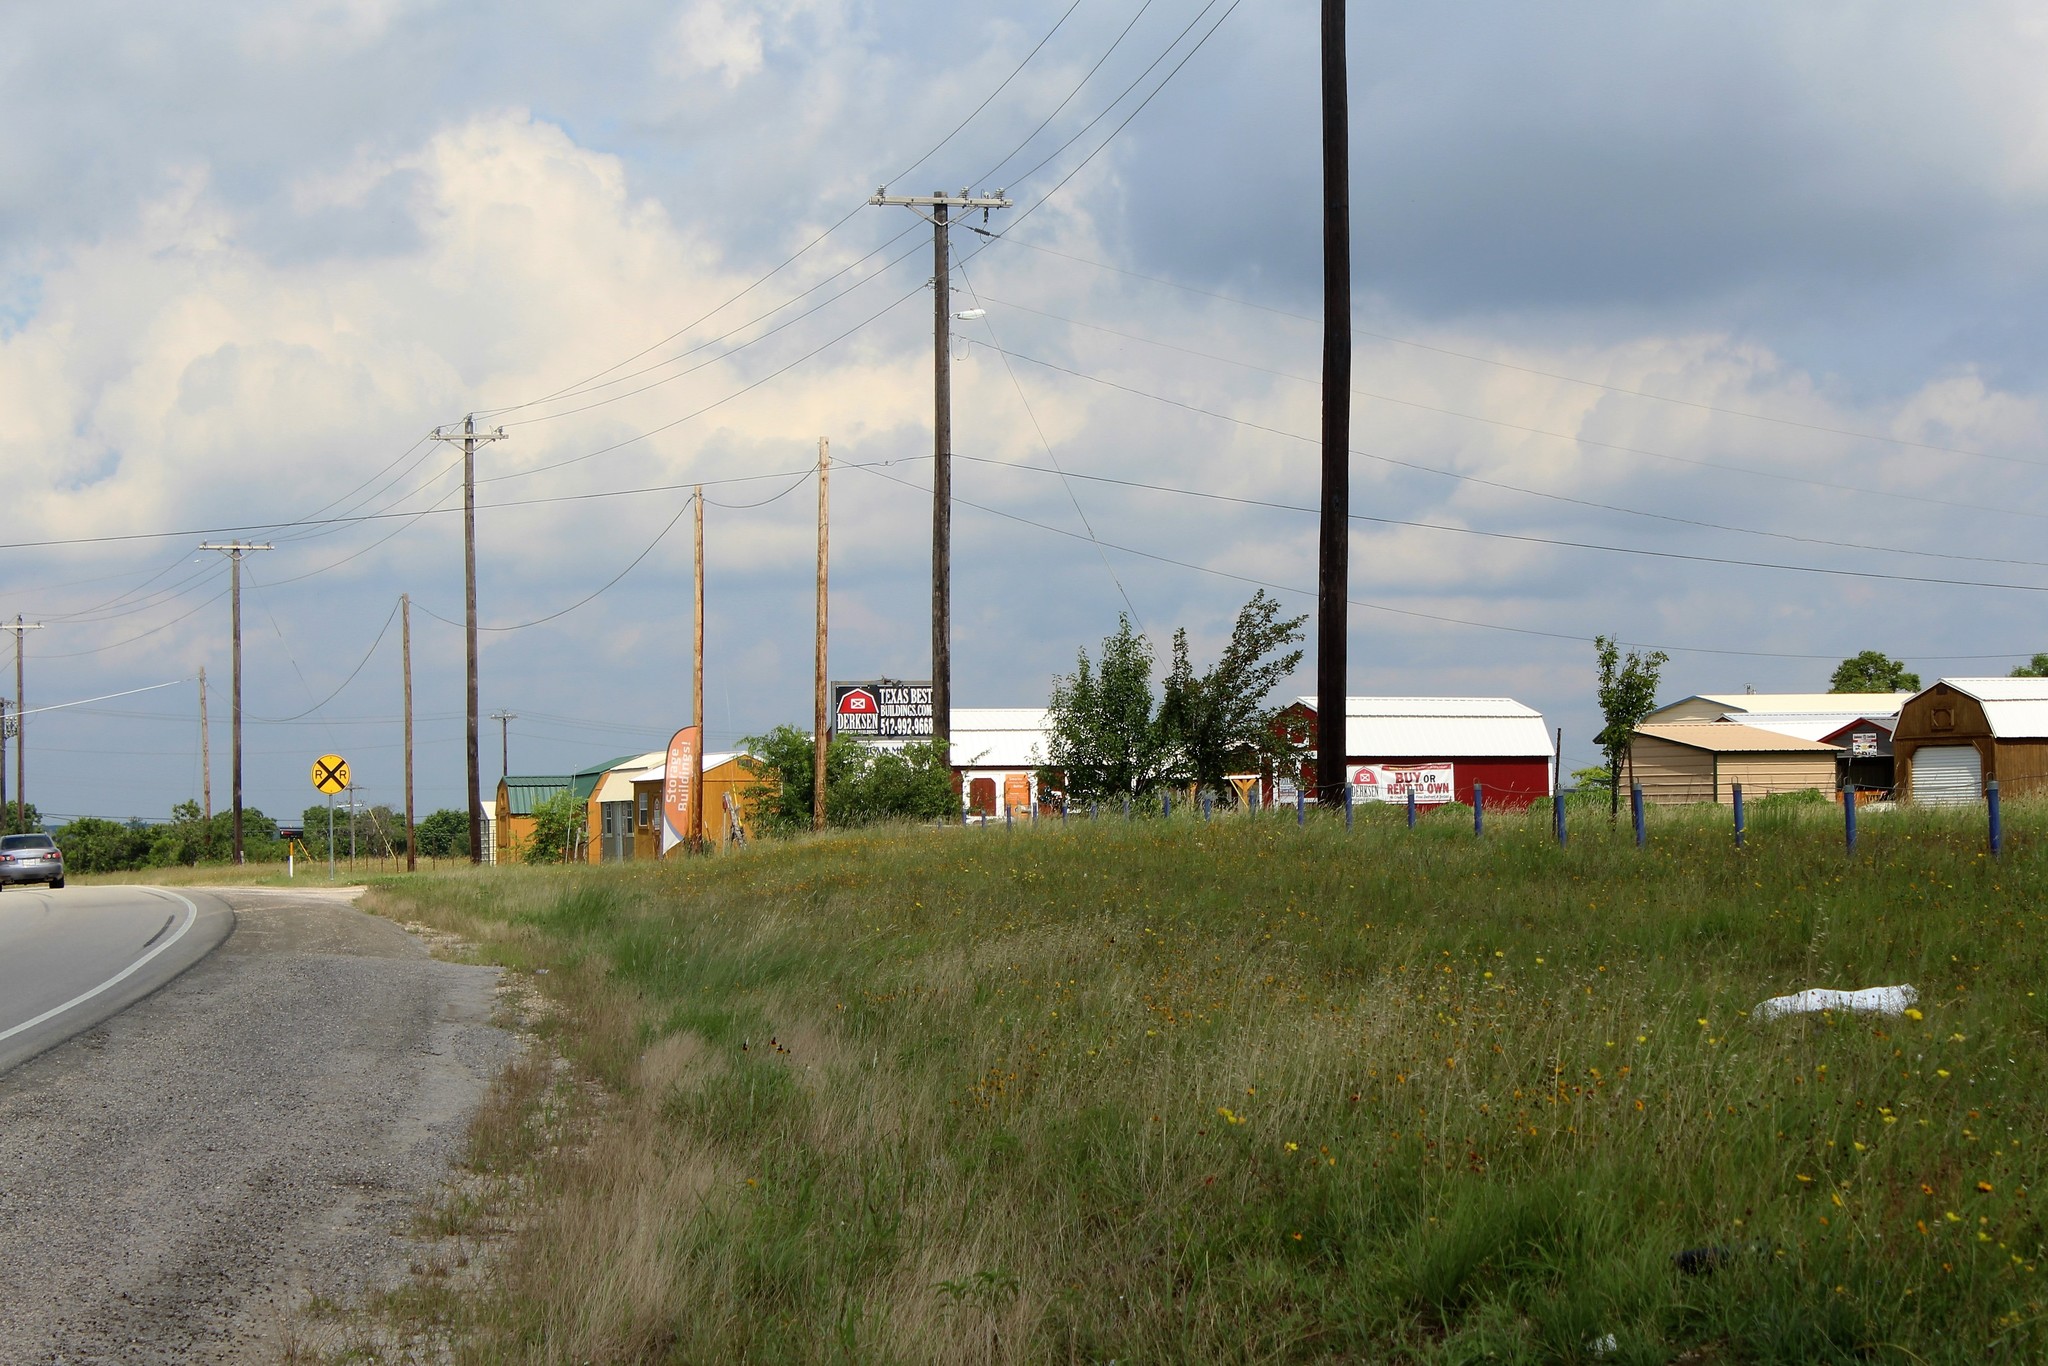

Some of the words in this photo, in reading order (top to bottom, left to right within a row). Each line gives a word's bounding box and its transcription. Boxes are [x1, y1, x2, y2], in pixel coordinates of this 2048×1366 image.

[879, 688, 909, 704] TEXAS
[910, 688, 933, 704] BEST
[880, 705, 933, 717] BUILDINGS.COM
[837, 713, 878, 730] DERKSEN
[880, 717, 933, 735] 512-992-9668
[315, 769, 323, 779] R
[339, 769, 347, 779] R
[666, 747, 681, 803] Storage
[678, 741, 693, 812] Buildings!
[1395, 772, 1421, 784] BUY
[1423, 774, 1436, 783] OR
[1351, 785, 1379, 798] DERKSEN
[1414, 783, 1424, 792] TO
[1427, 783, 1449, 794] OWN
